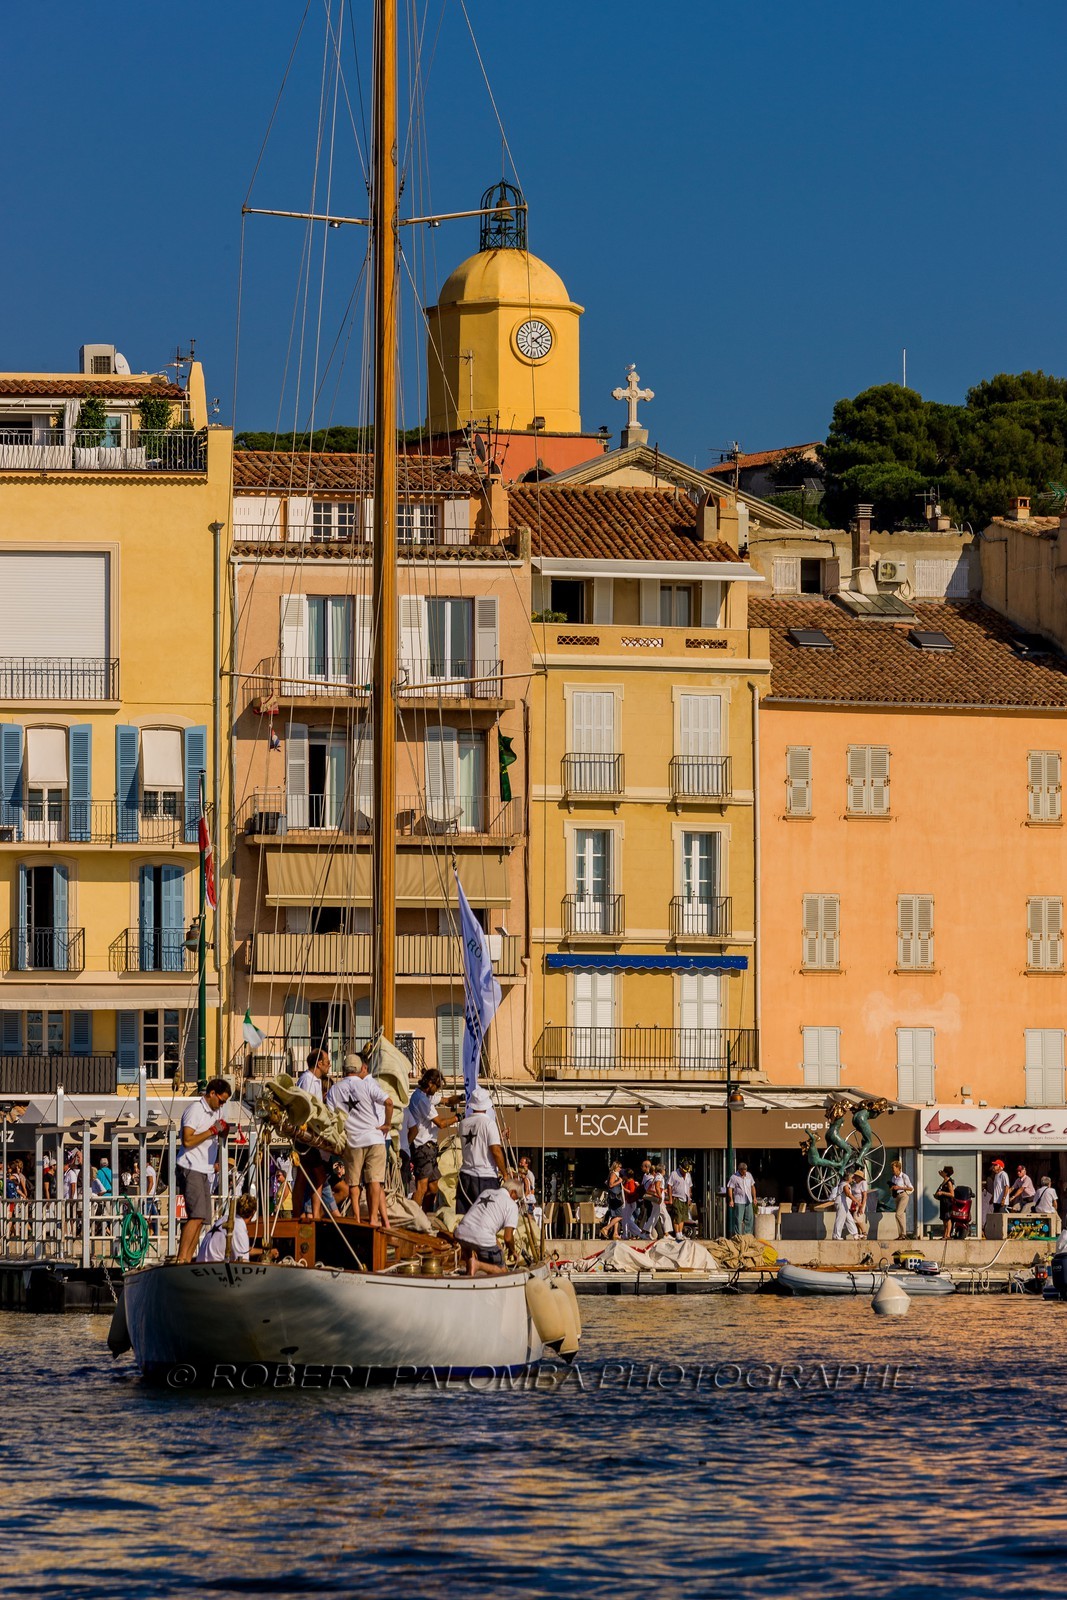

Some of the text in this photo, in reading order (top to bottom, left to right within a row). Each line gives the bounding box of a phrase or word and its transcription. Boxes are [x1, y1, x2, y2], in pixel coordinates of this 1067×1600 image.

[564, 1114, 649, 1136] L'ESCALE
[785, 1121, 824, 1132] Lounge
[191, 1266, 267, 1277] EILIDH
